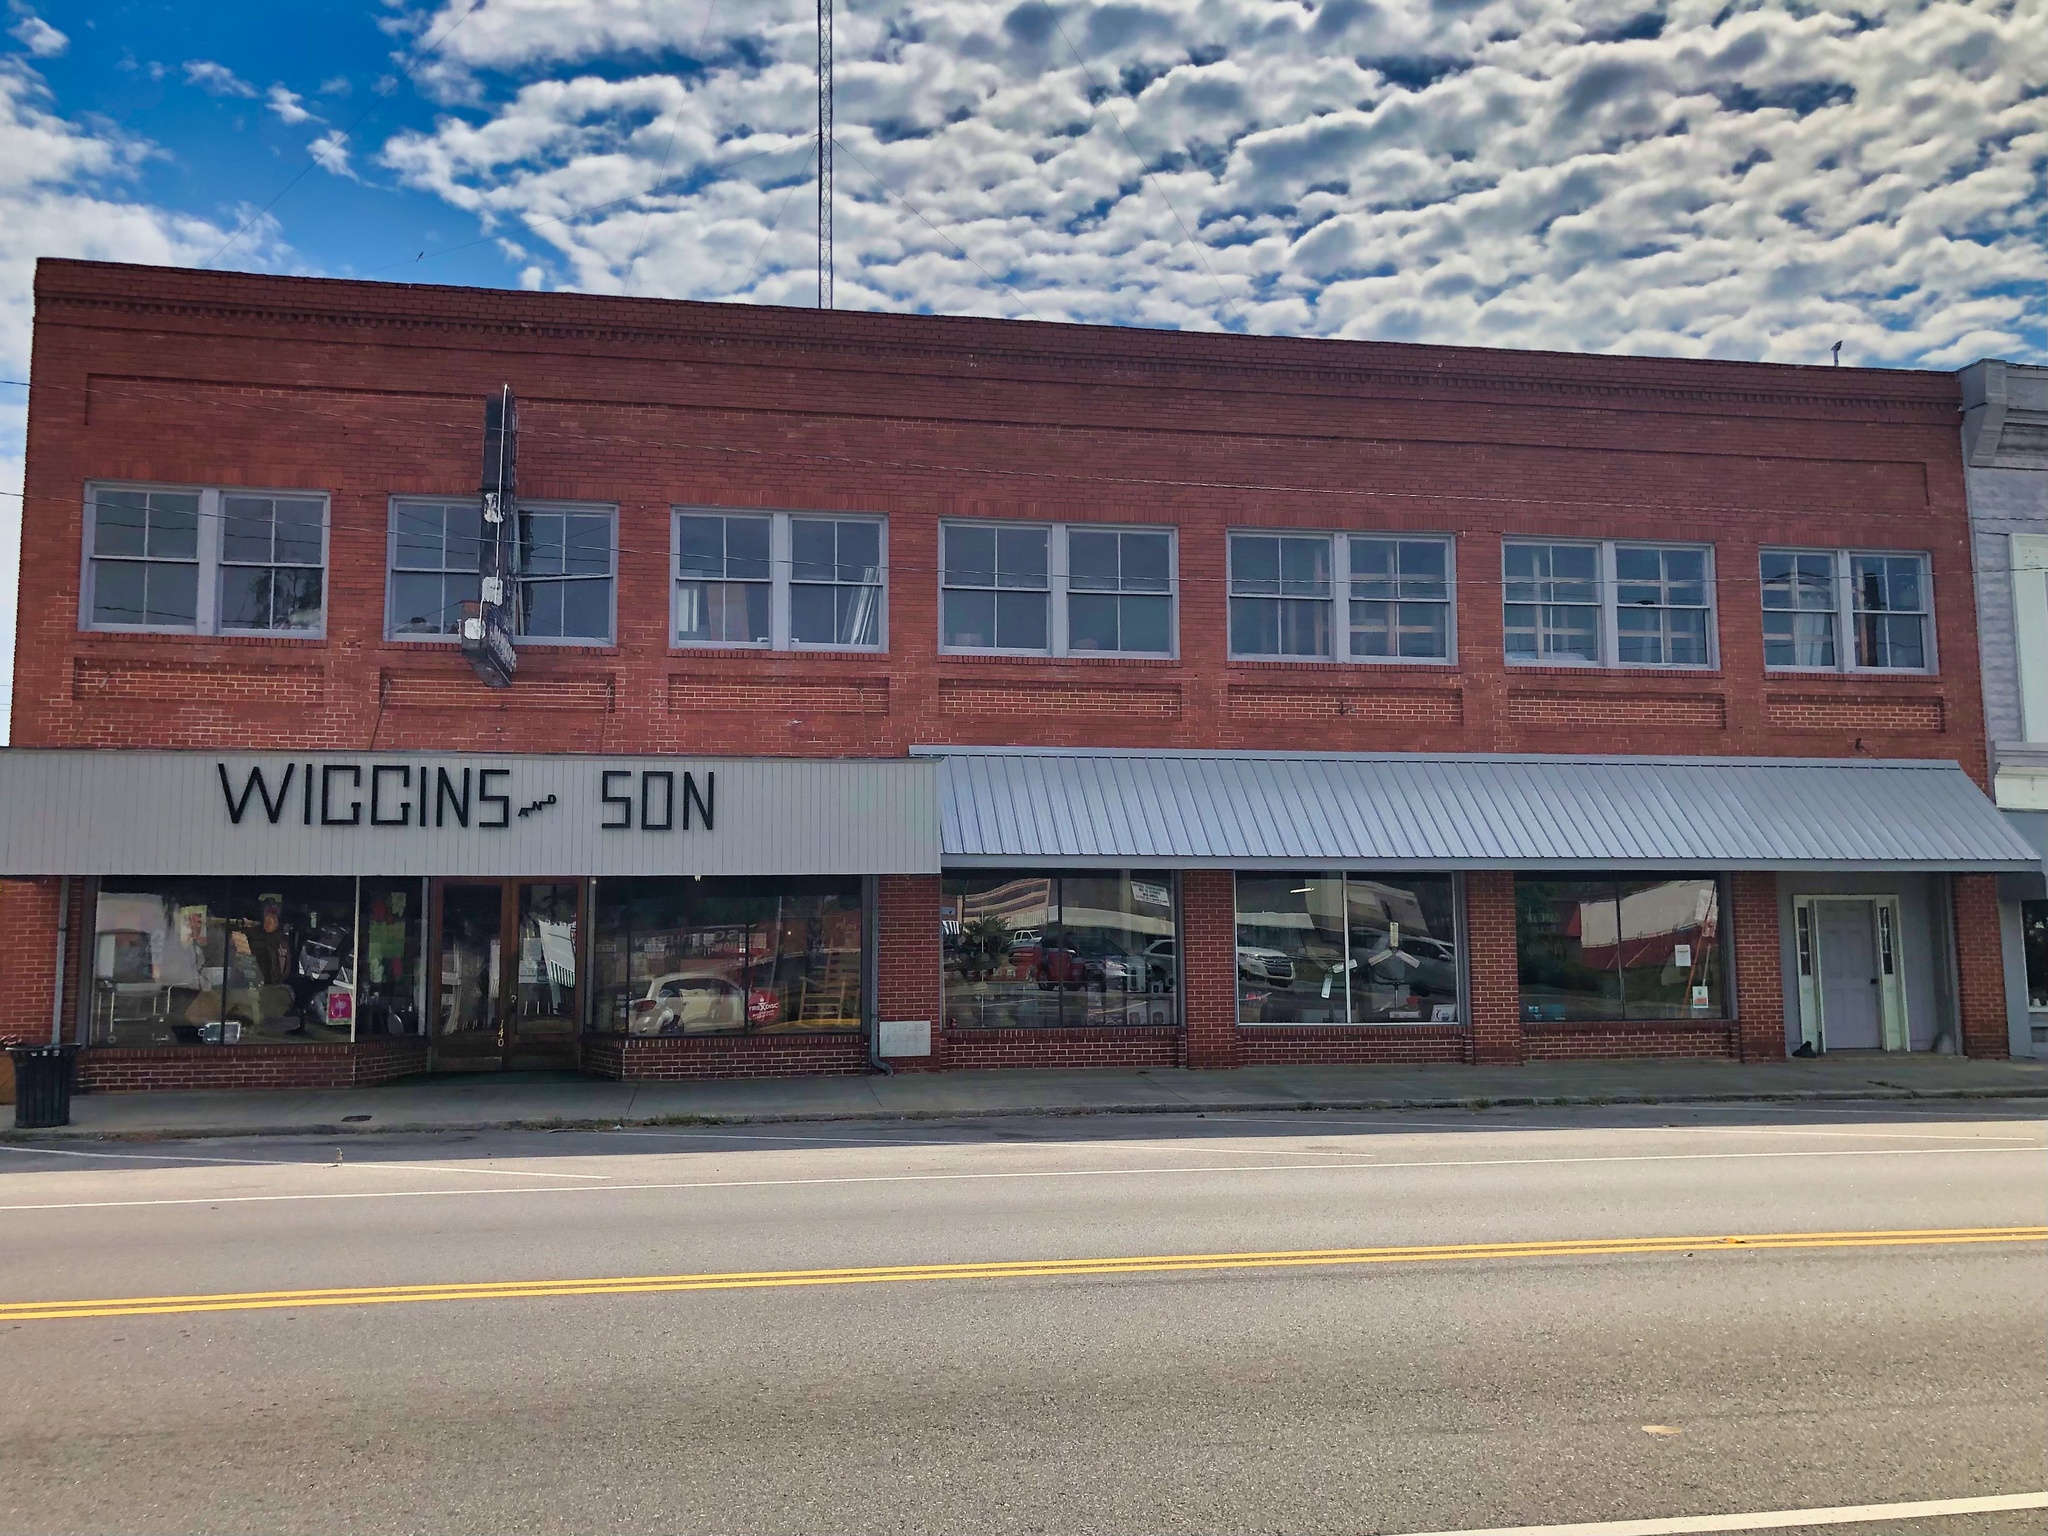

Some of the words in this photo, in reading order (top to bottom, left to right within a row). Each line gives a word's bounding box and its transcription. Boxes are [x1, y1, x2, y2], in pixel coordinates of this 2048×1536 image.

[218, 762, 510, 828] WIGGINS
[518, 794, 557, 817] AND
[601, 770, 715, 831] SON
